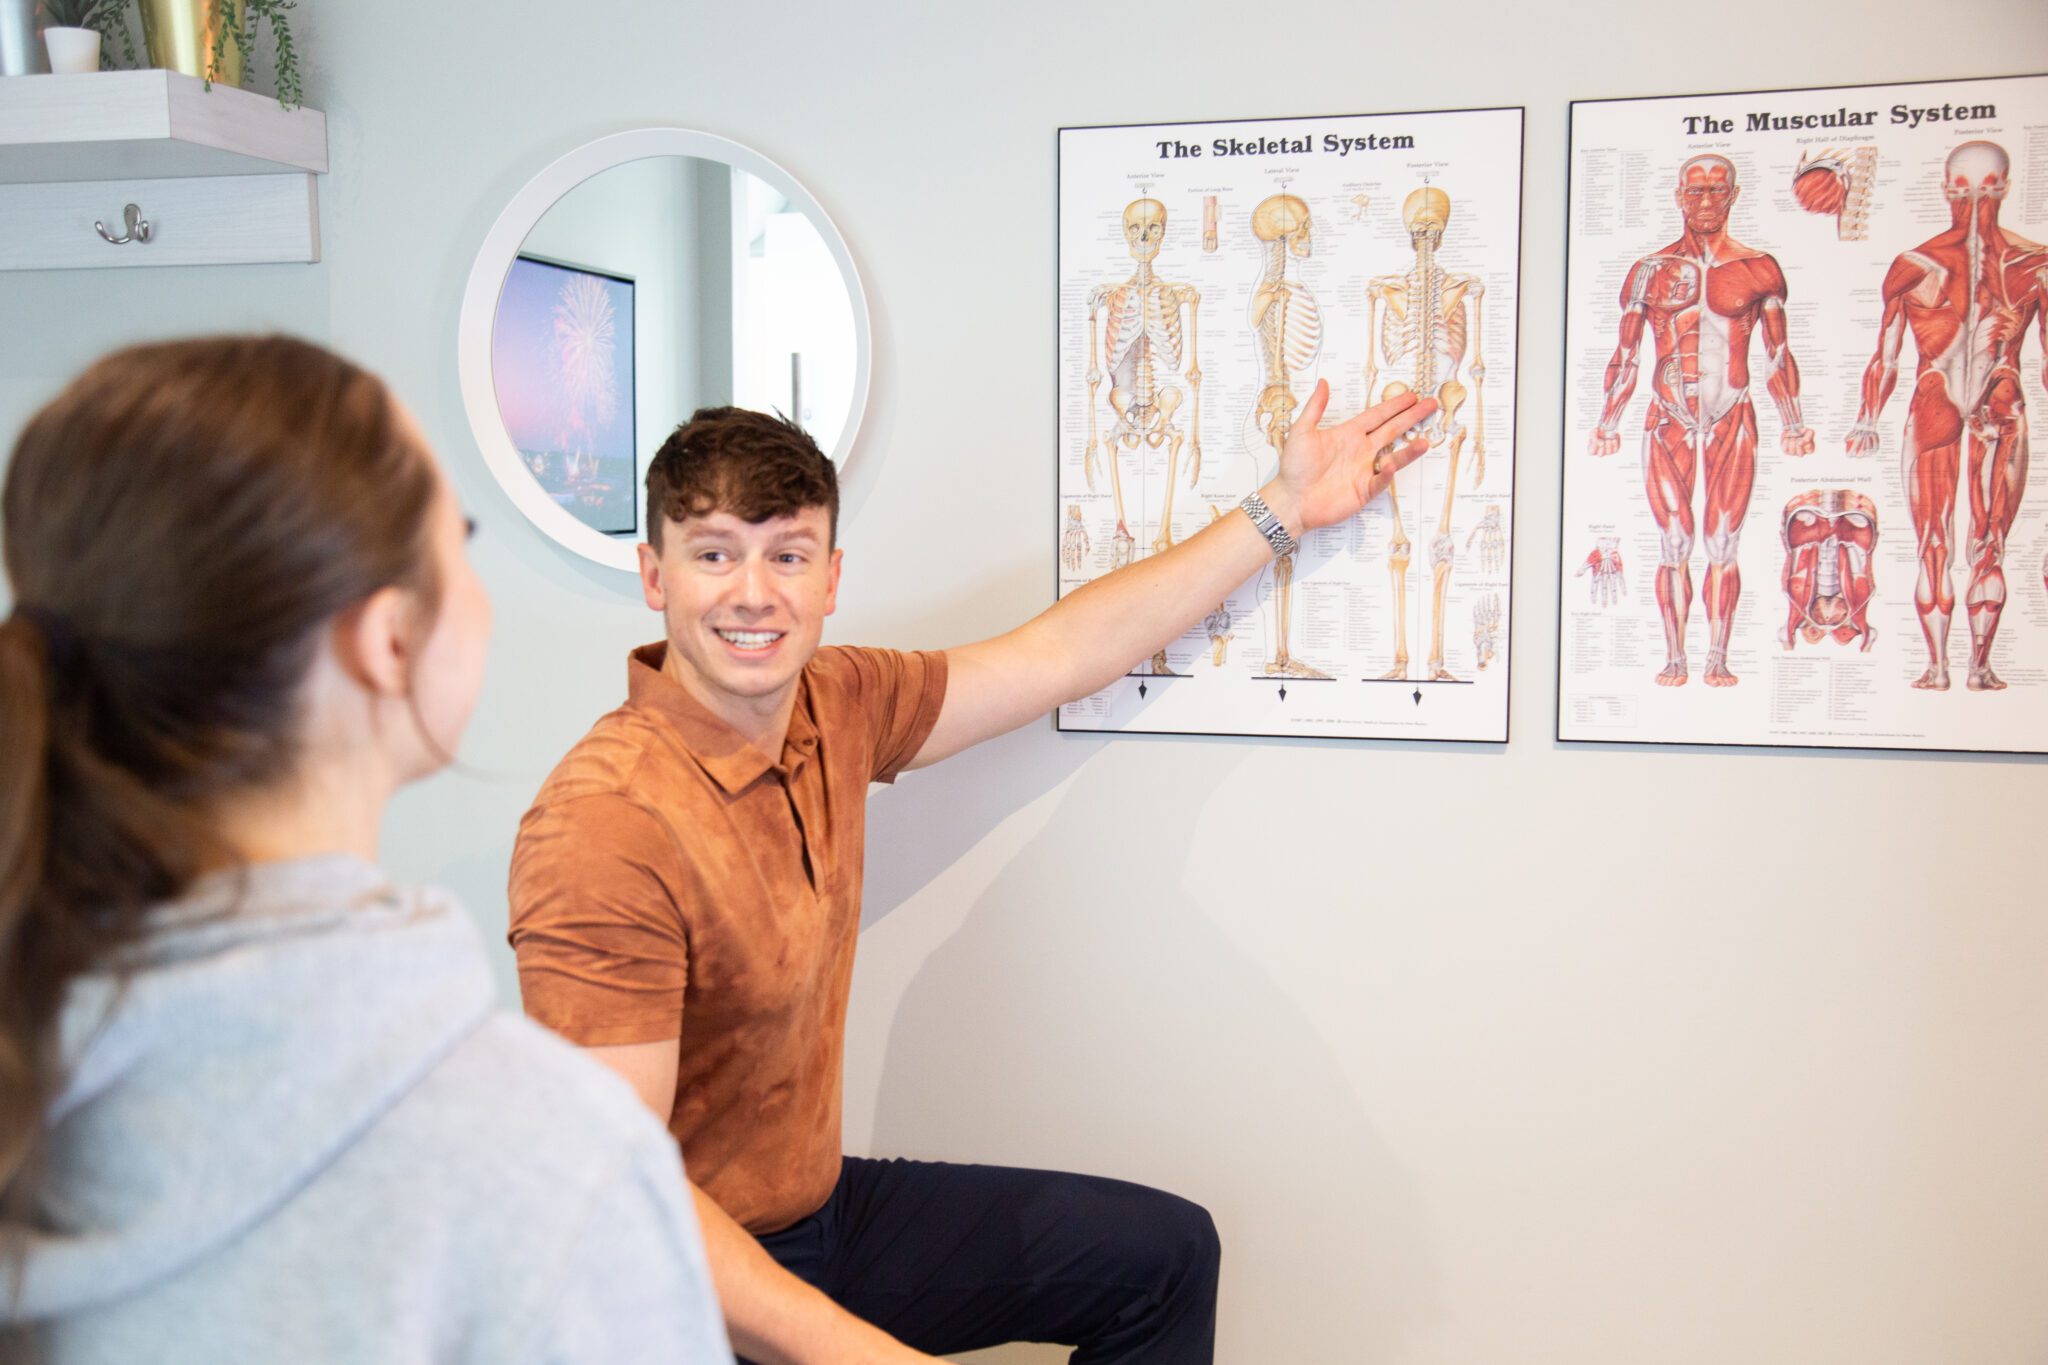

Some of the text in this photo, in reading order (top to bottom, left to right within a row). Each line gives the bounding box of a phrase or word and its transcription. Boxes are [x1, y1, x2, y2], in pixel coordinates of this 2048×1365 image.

[1682, 102, 1997, 135] The Muscular System
[1156, 132, 1415, 159] The Skeletal System
